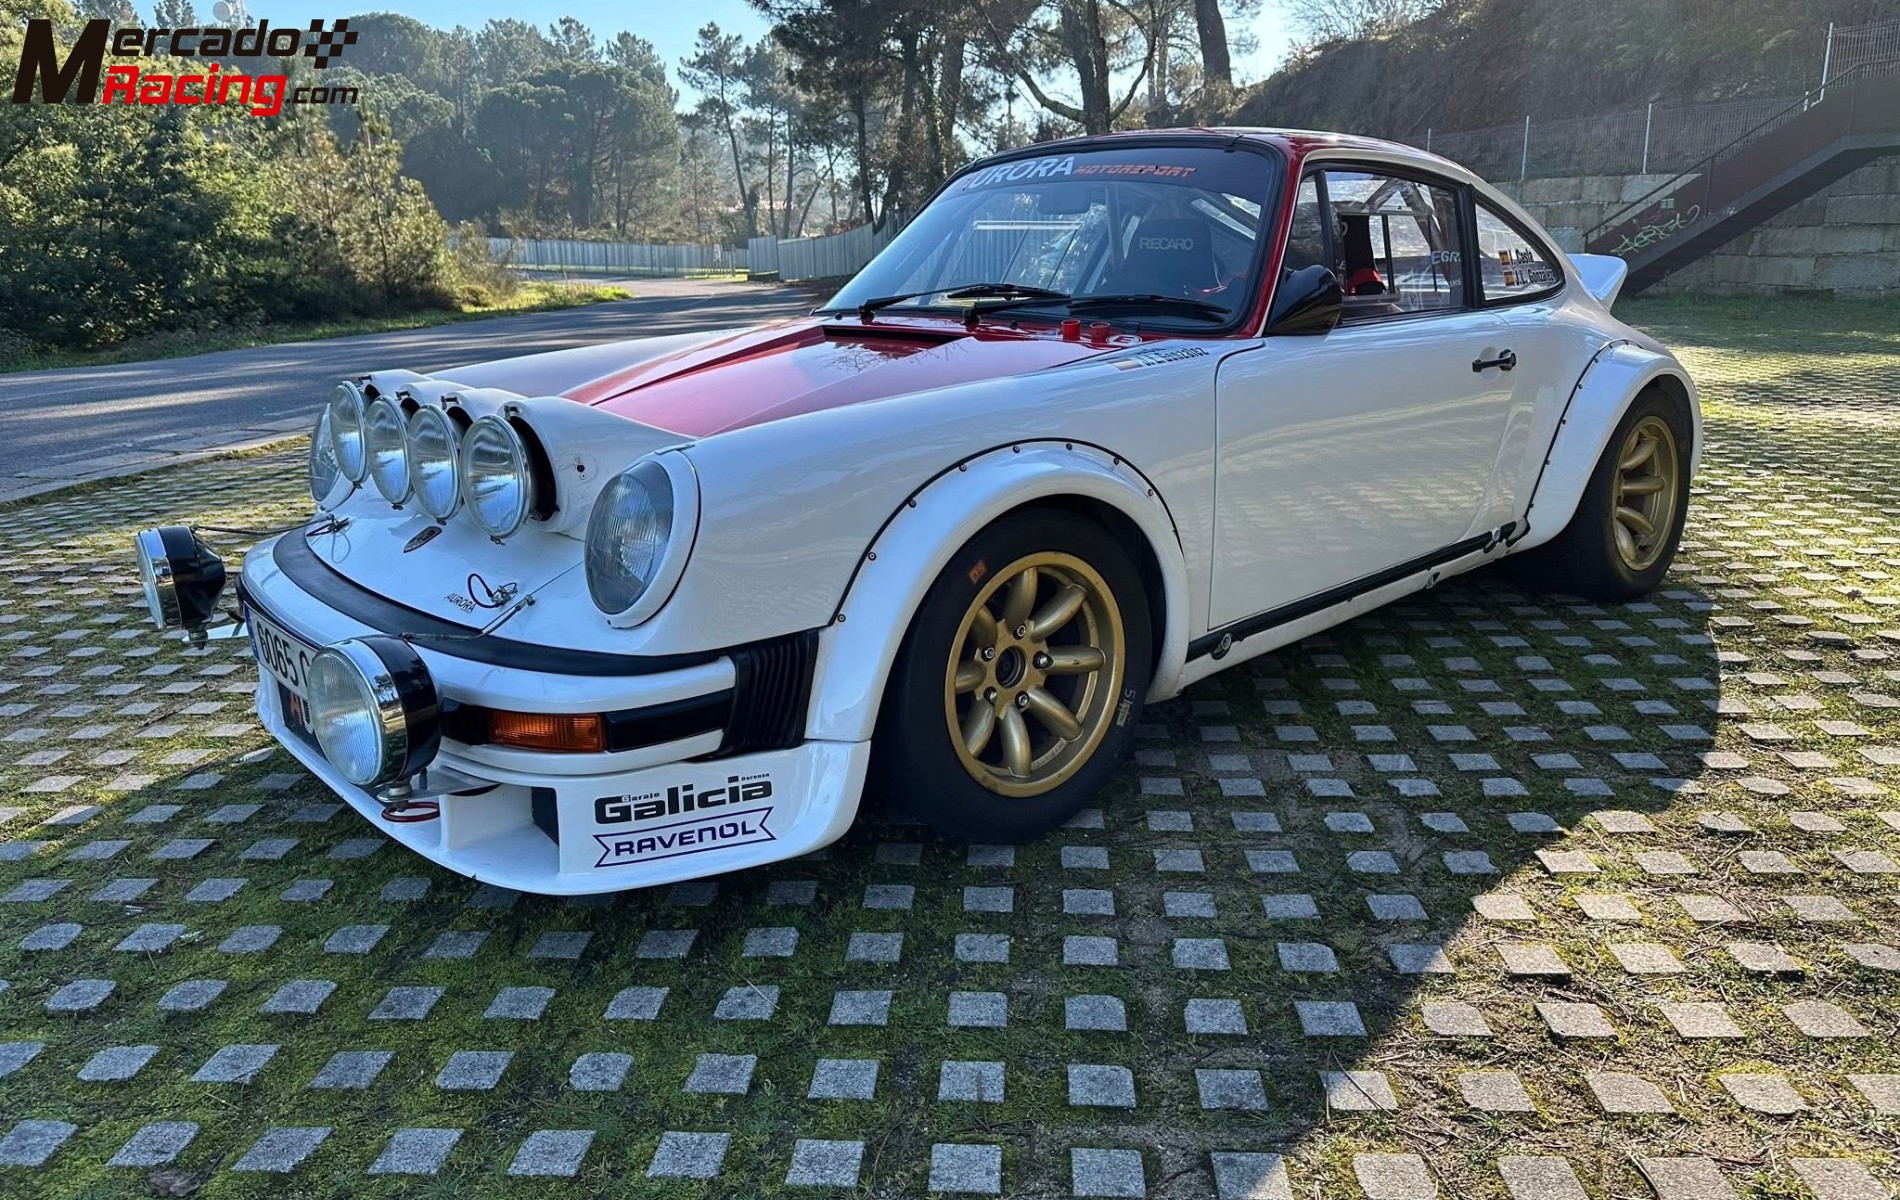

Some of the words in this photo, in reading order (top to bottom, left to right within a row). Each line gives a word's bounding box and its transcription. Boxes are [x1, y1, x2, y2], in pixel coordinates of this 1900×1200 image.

[960, 156, 1075, 189] URORA
[1072, 164, 1197, 178] MOTORSPORT
[1139, 237, 1194, 251] RECARO
[443, 592, 476, 612] AURORA
[256, 620, 300, 687] 6065
[595, 775, 773, 825] Galicia
[614, 820, 757, 857] RAVENOL
